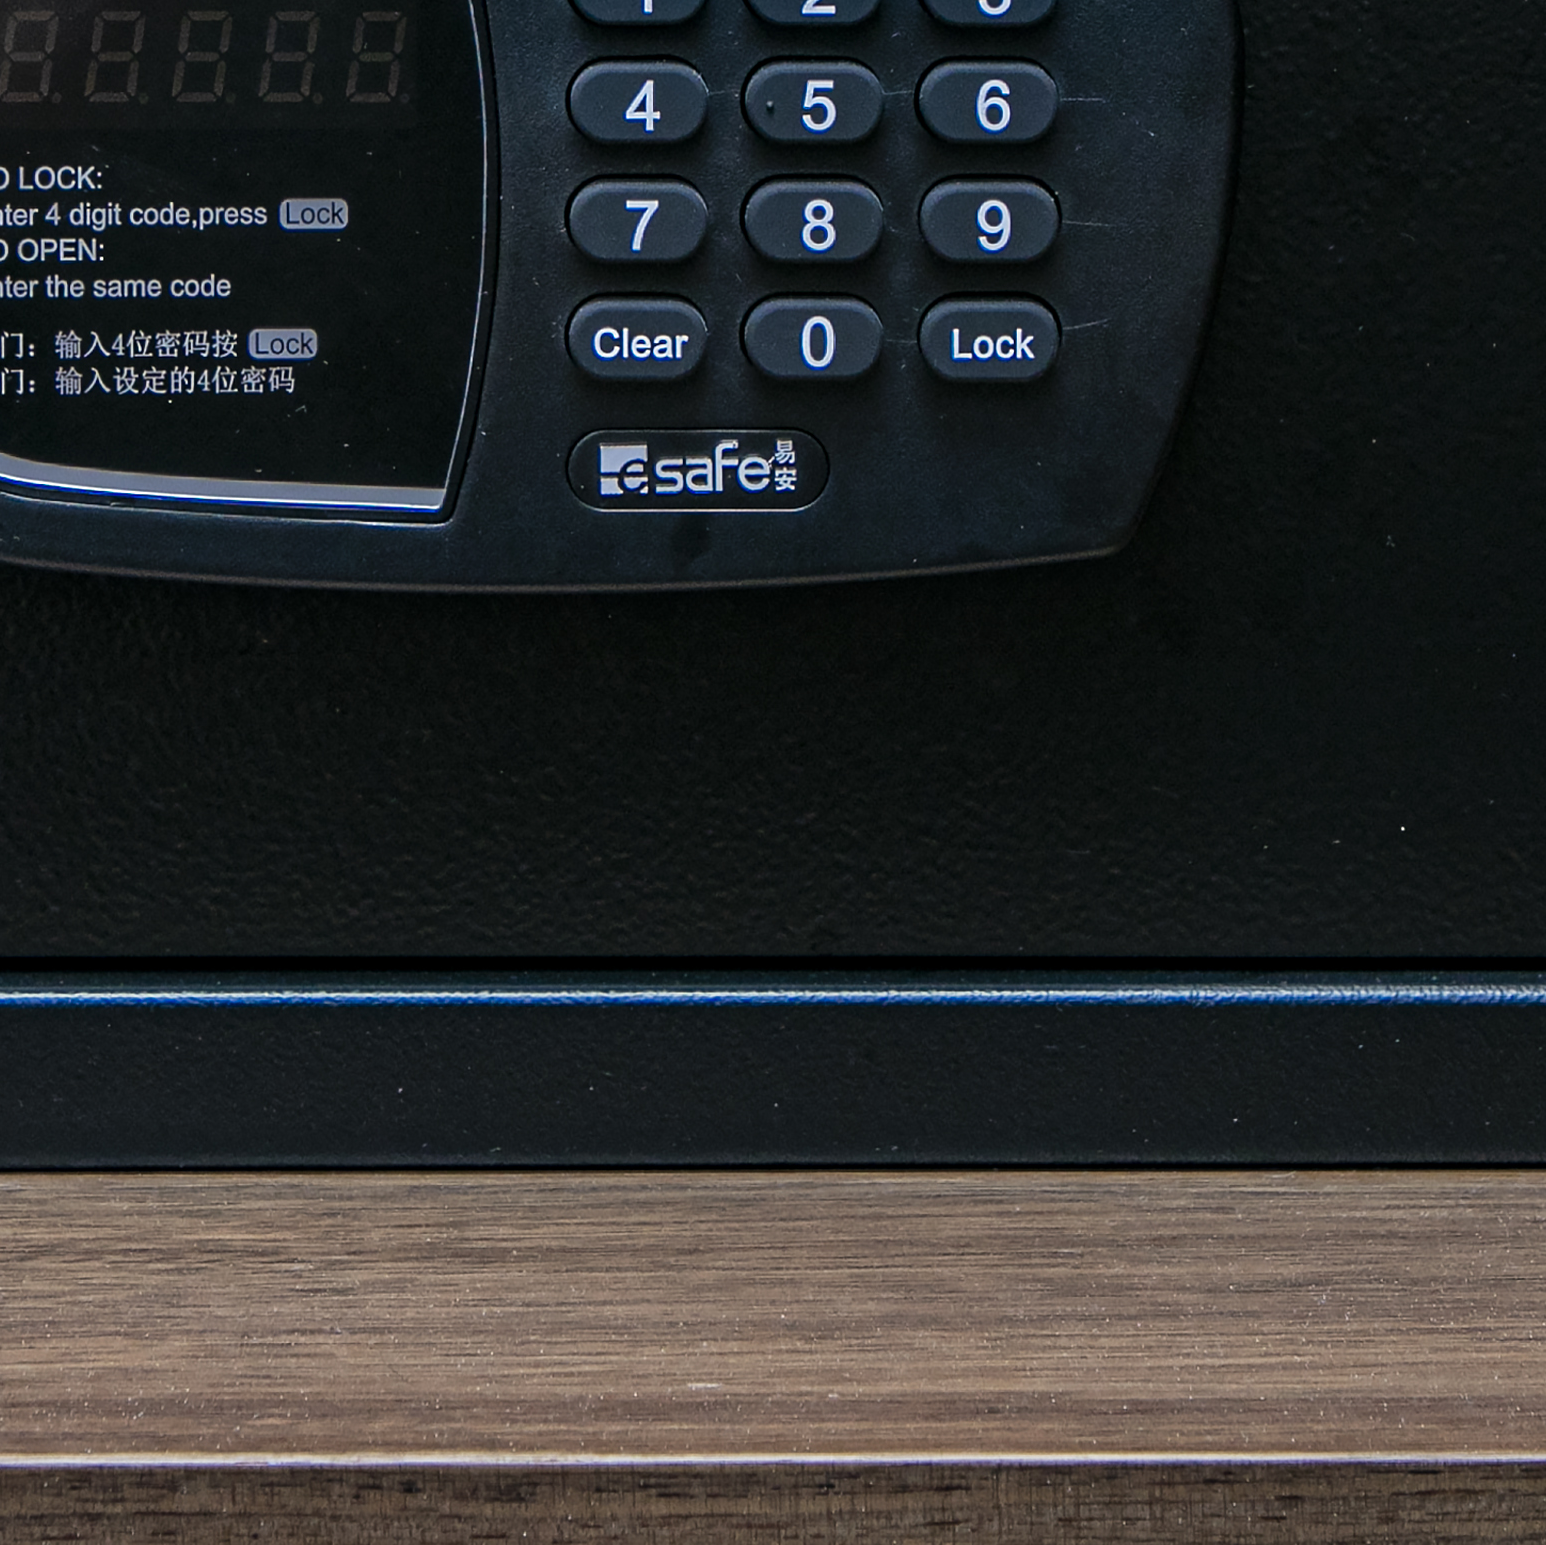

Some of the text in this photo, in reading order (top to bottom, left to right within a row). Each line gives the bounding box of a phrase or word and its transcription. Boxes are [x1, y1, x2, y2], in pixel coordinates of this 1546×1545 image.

[624, 80, 1011, 132] 4 5 6
[18, 166, 103, 190] LOCK:
[45, 204, 61, 226] 4
[69, 203, 122, 232] digit
[129, 204, 268, 231] code,press
[285, 202, 344, 224] Lock
[625, 200, 1011, 252] 7 8 9
[17, 238, 105, 262] OPEN:
[45, 276, 85, 299] the
[93, 281, 162, 299] same
[170, 275, 231, 298] code
[254, 332, 313, 354] Lock
[593, 316, 1035, 368] Clear 0 Lock
